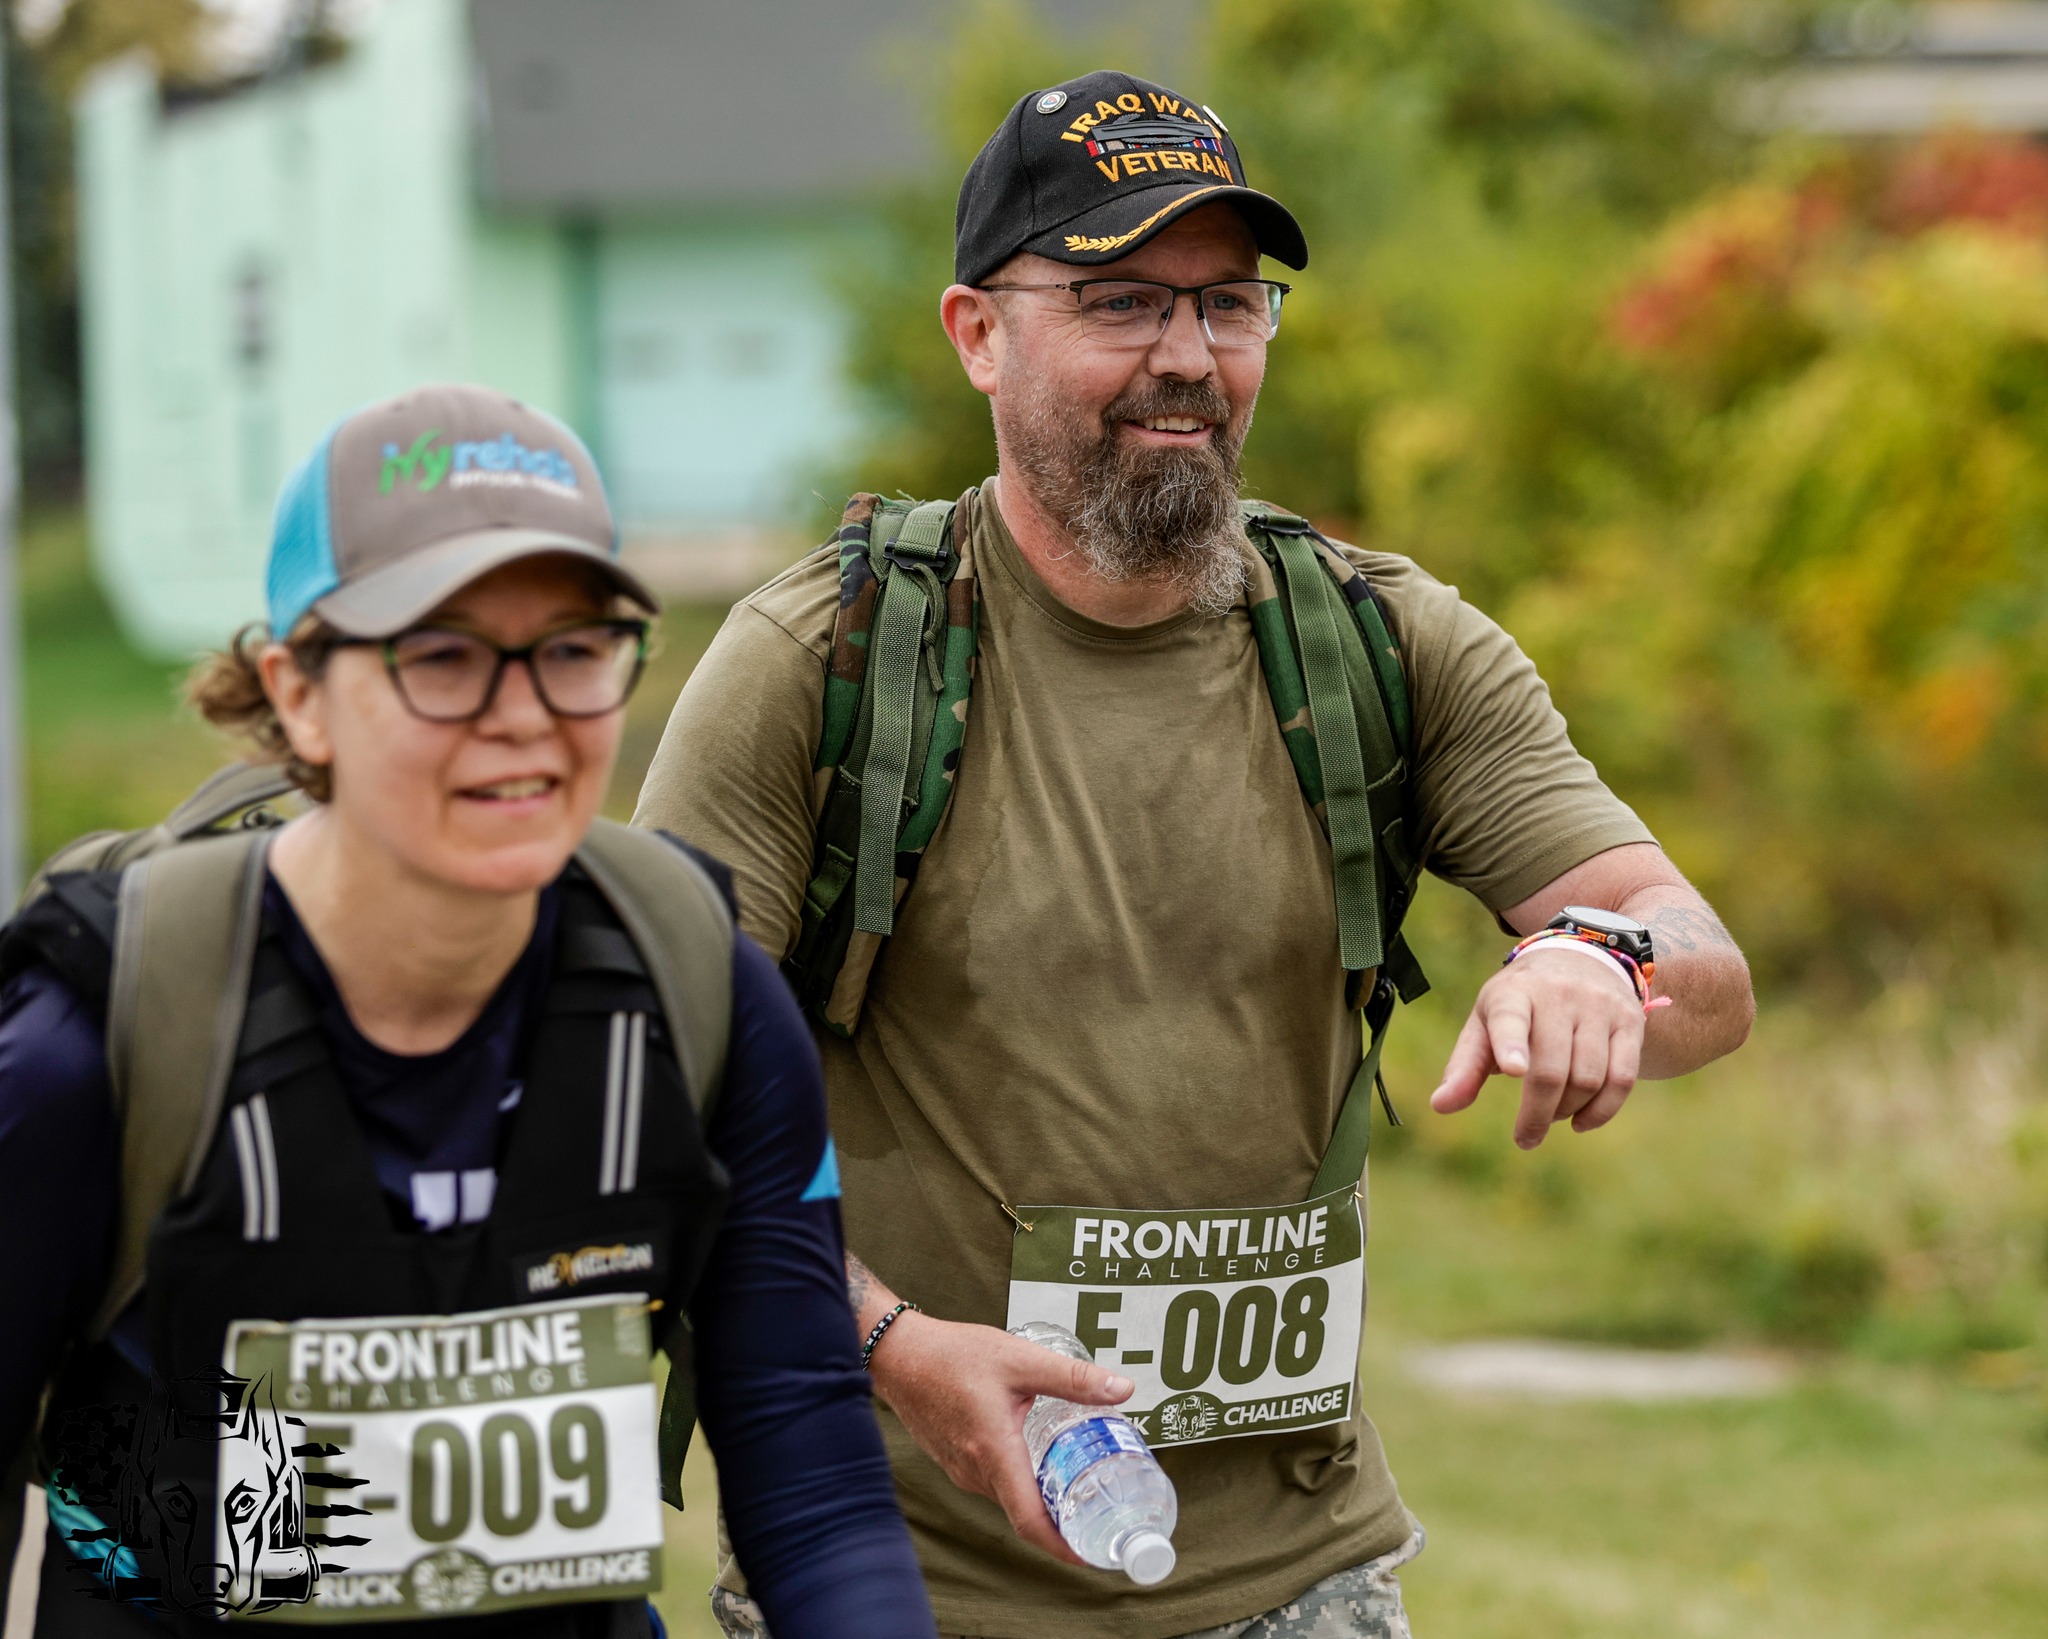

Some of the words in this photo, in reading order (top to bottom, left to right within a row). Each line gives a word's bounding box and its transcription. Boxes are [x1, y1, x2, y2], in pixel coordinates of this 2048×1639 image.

[1060, 93, 1145, 143] IRAQ
[1095, 150, 1234, 184] VETERAN
[1073, 1206, 1328, 1259] FRONTLINE
[1069, 1247, 1324, 1279] CHALLENGE
[290, 1312, 585, 1384] FRONTLINE
[286, 1364, 590, 1408] CHALLENGE
[1223, 1388, 1344, 1426] CHALLENGE
[491, 1551, 650, 1595] CHALLENGE
